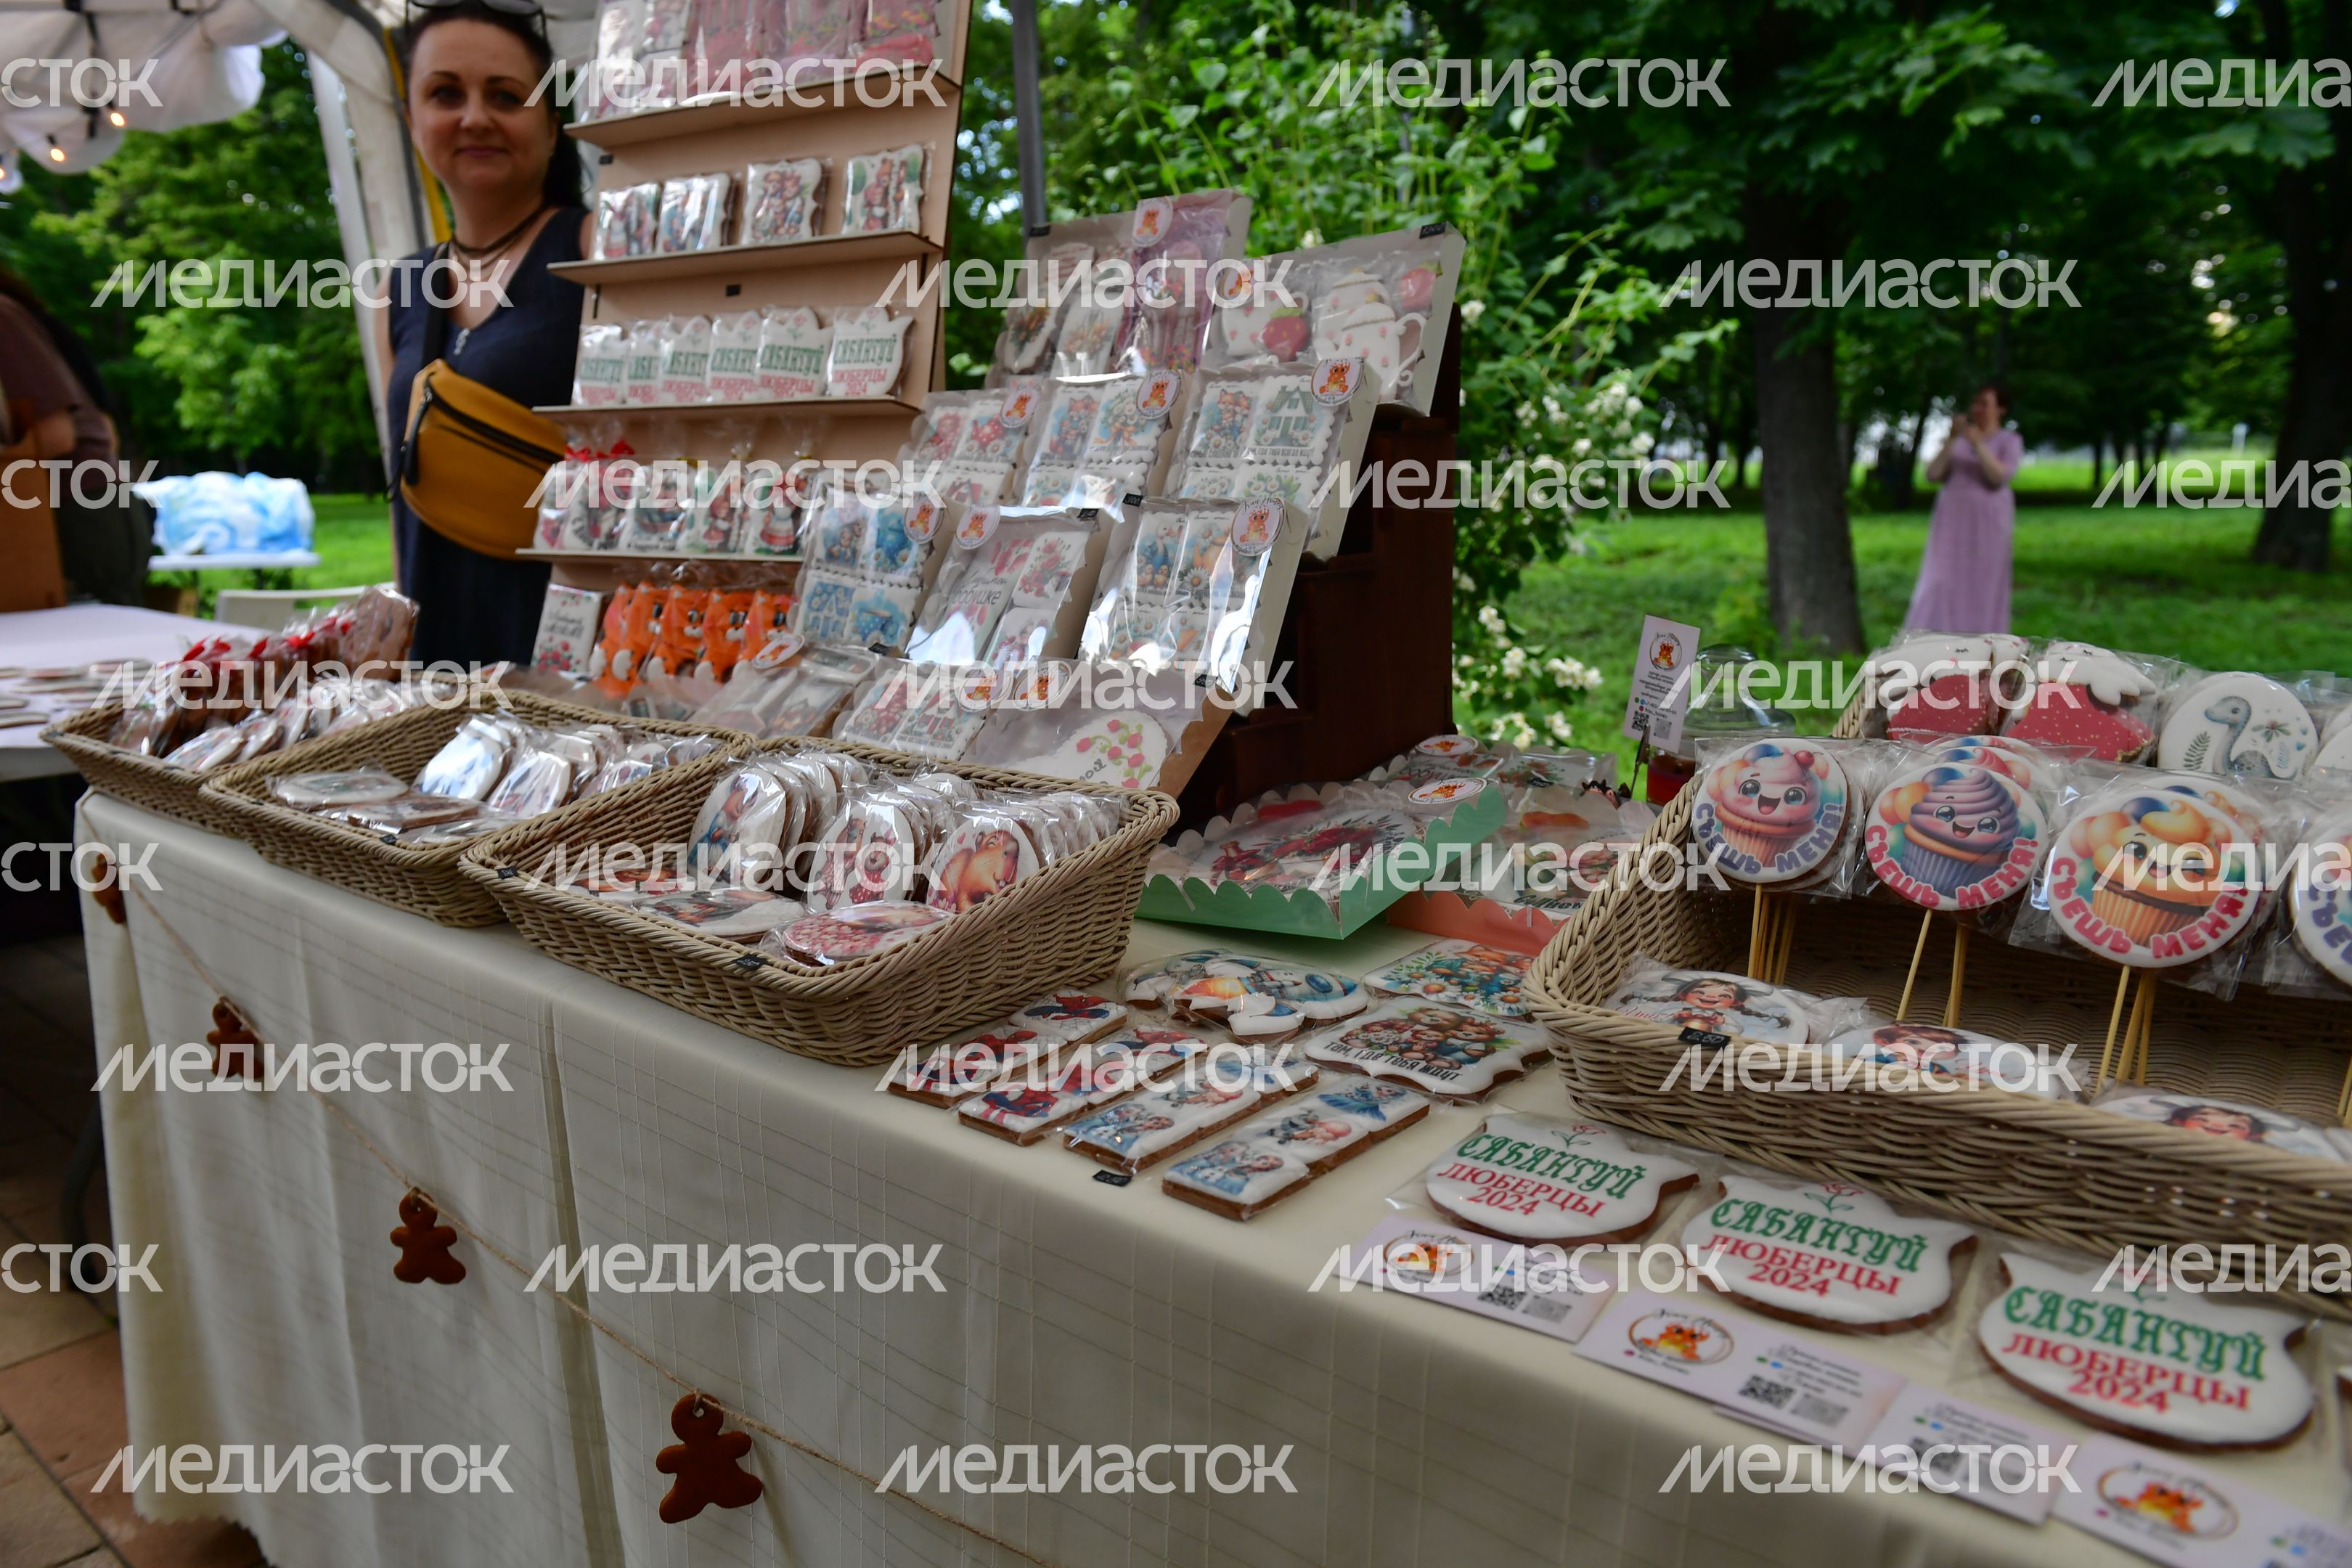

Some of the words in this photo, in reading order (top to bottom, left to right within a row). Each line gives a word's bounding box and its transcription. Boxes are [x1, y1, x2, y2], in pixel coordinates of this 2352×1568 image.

[834, 334, 897, 366] САБАНТУЙ
[834, 368, 888, 385] ЛЮБЕРЦЫ
[1695, 803, 1763, 874] СЪЕШЬ
[1776, 804, 1844, 873] МЕНЯ!
[1865, 825, 1940, 908] СЪЕШЬ
[1956, 838, 2038, 908] МЕНЯ!
[2053, 857, 2133, 954] СЪЕШЬ
[1437, 1163, 1608, 1217] ЛЮБЕРЦЫ
[1457, 1133, 1646, 1199] САБАНТУЙ
[1467, 1187, 1541, 1216] 2024
[1701, 1234, 1903, 1296] ЛЮБЕРЦЫ
[1711, 1198, 1928, 1273] САБАНТУЙ
[1747, 1262, 1832, 1297] 2024
[2004, 1286, 2266, 1381] САБАНТУЙ
[2001, 1333, 2252, 1410] ЛЮБЕРЦЫ
[2067, 1369, 2170, 1413] 2024
